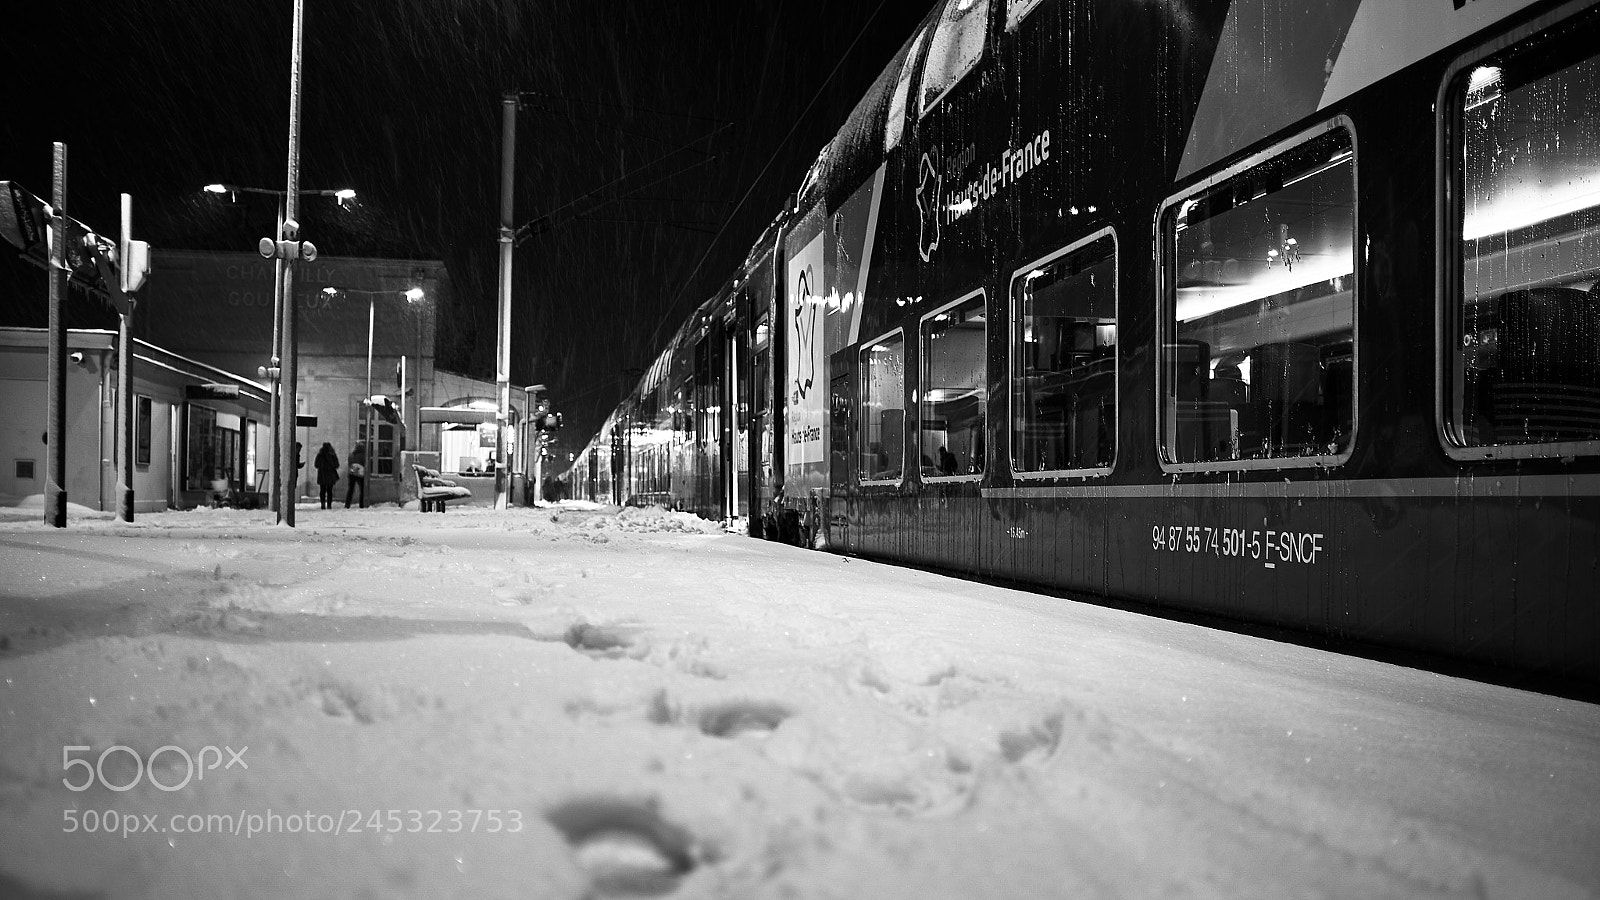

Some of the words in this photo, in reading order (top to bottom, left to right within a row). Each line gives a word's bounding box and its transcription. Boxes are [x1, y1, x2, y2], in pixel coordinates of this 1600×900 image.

[946, 129, 1050, 226] Hauts-de-France
[226, 265, 337, 283] CHAILLY
[228, 291, 333, 310] GOUEUX
[1152, 525, 1166, 550] 94
[1168, 526, 1183, 552] 87
[1185, 526, 1201, 553] 55
[1204, 527, 1219, 554] 74
[1222, 528, 1261, 560] 501-5
[1265, 530, 1324, 565] F-SNCF
